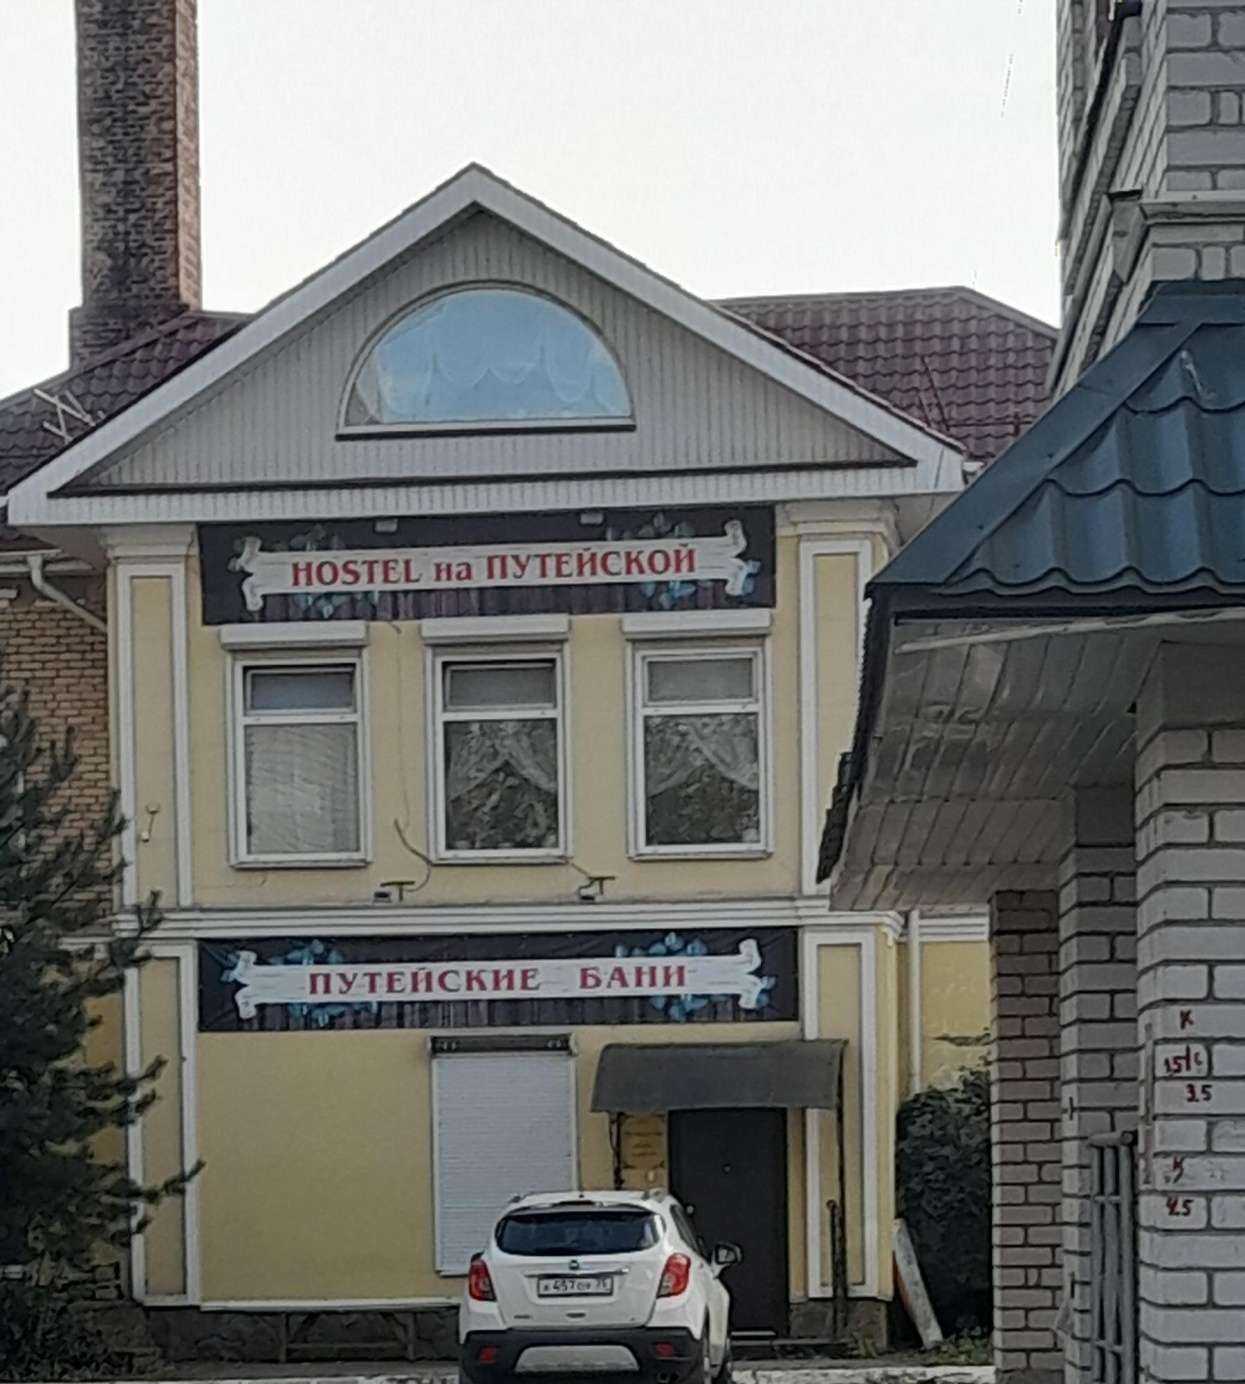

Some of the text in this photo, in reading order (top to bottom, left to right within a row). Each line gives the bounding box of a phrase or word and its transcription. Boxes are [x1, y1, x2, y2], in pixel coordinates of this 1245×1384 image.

[291, 543, 697, 587] HOSTEL на ПУТЕЙСКОЙ
[309, 965, 686, 995] ПУТЕЙСКИЕ БАНИ
